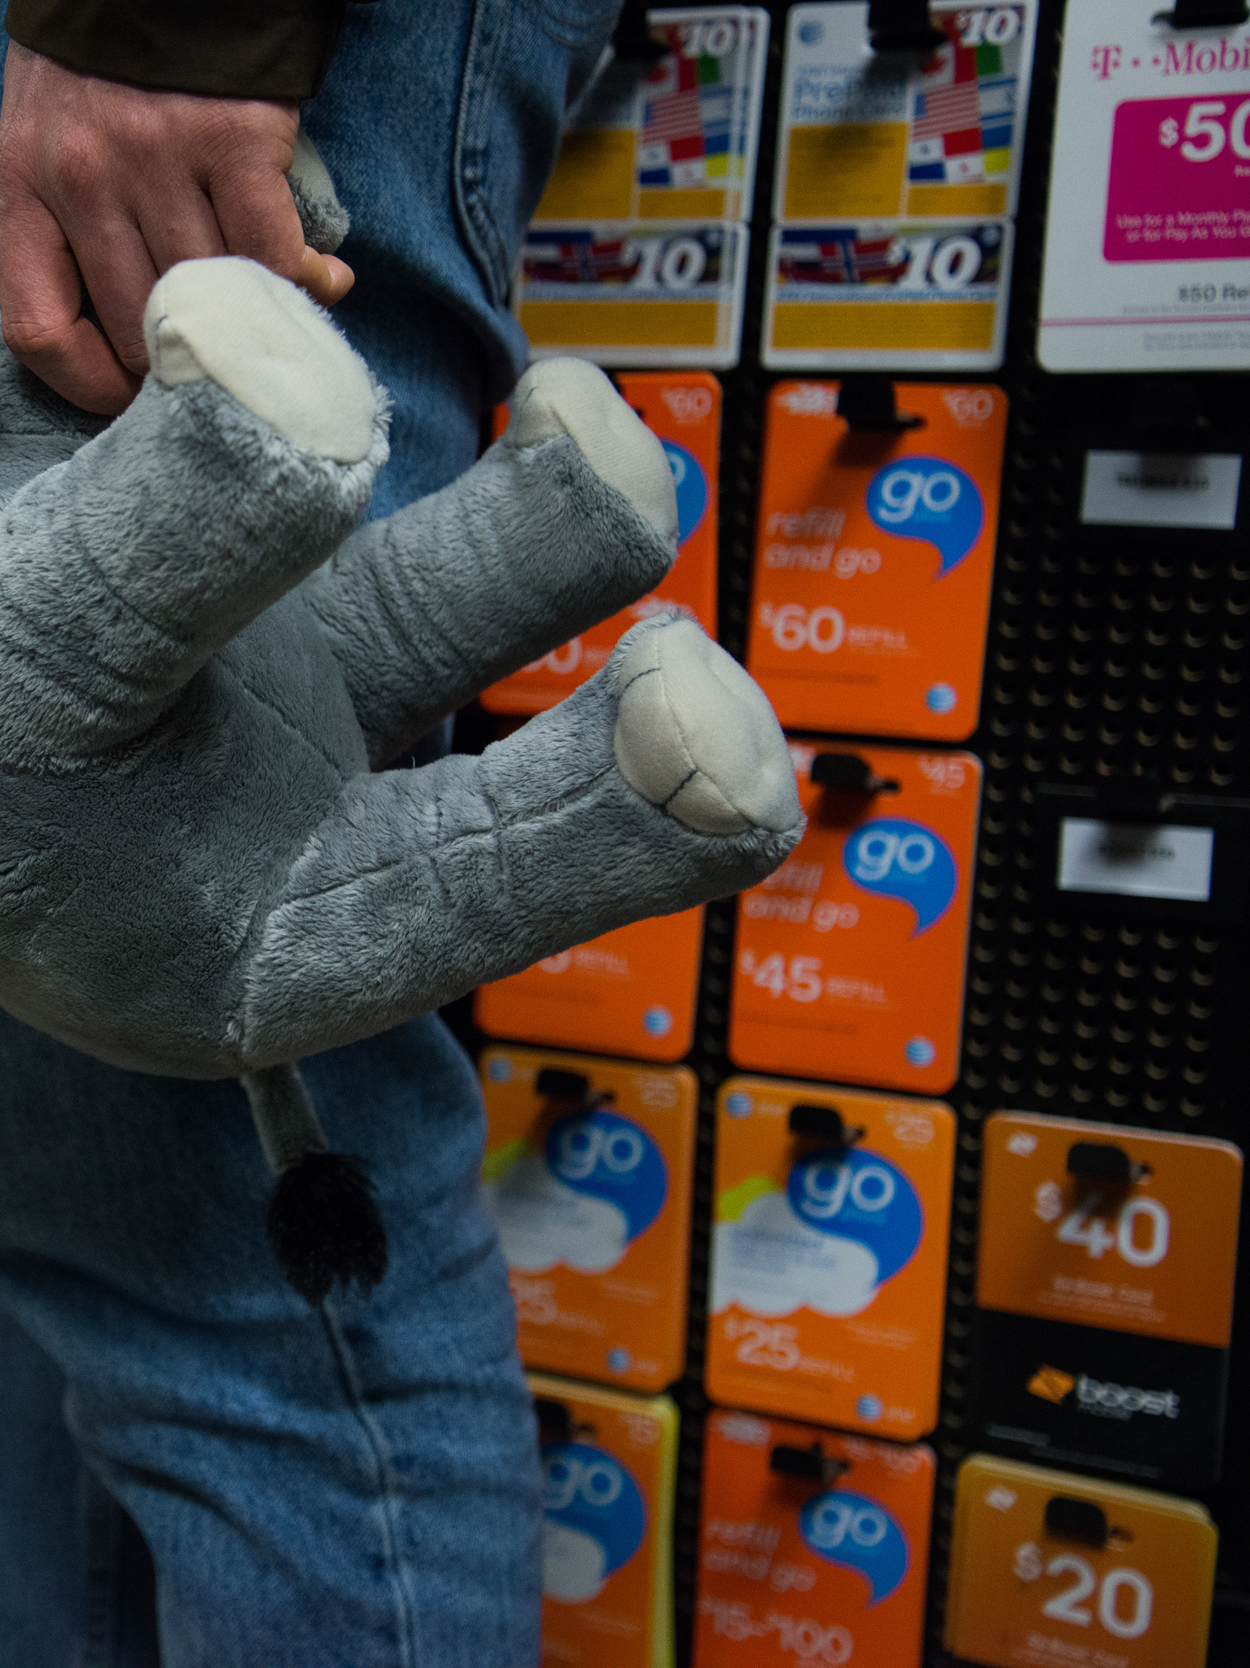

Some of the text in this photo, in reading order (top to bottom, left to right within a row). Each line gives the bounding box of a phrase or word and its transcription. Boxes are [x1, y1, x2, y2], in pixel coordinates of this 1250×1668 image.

[1165, 226, 1189, 243] Pay
[1212, 223, 1237, 239] You
[1177, 209, 1230, 227] Monthly
[622, 238, 708, 292] $10
[887, 236, 982, 293] $10
[766, 506, 846, 540] refill
[877, 469, 962, 524] go
[763, 541, 883, 580] and go
[760, 602, 846, 654] $60
[853, 829, 935, 882] go
[743, 892, 860, 933] and go
[740, 948, 824, 1004] $45
[558, 1125, 645, 1181] go
[800, 1158, 896, 1220] go
[1035, 1180, 1171, 1269] $40
[723, 1316, 801, 1371] $25
[1076, 1373, 1181, 1420] boost
[542, 1452, 623, 1510] go
[806, 1499, 888, 1549] go
[1012, 1541, 1154, 1640] $20
